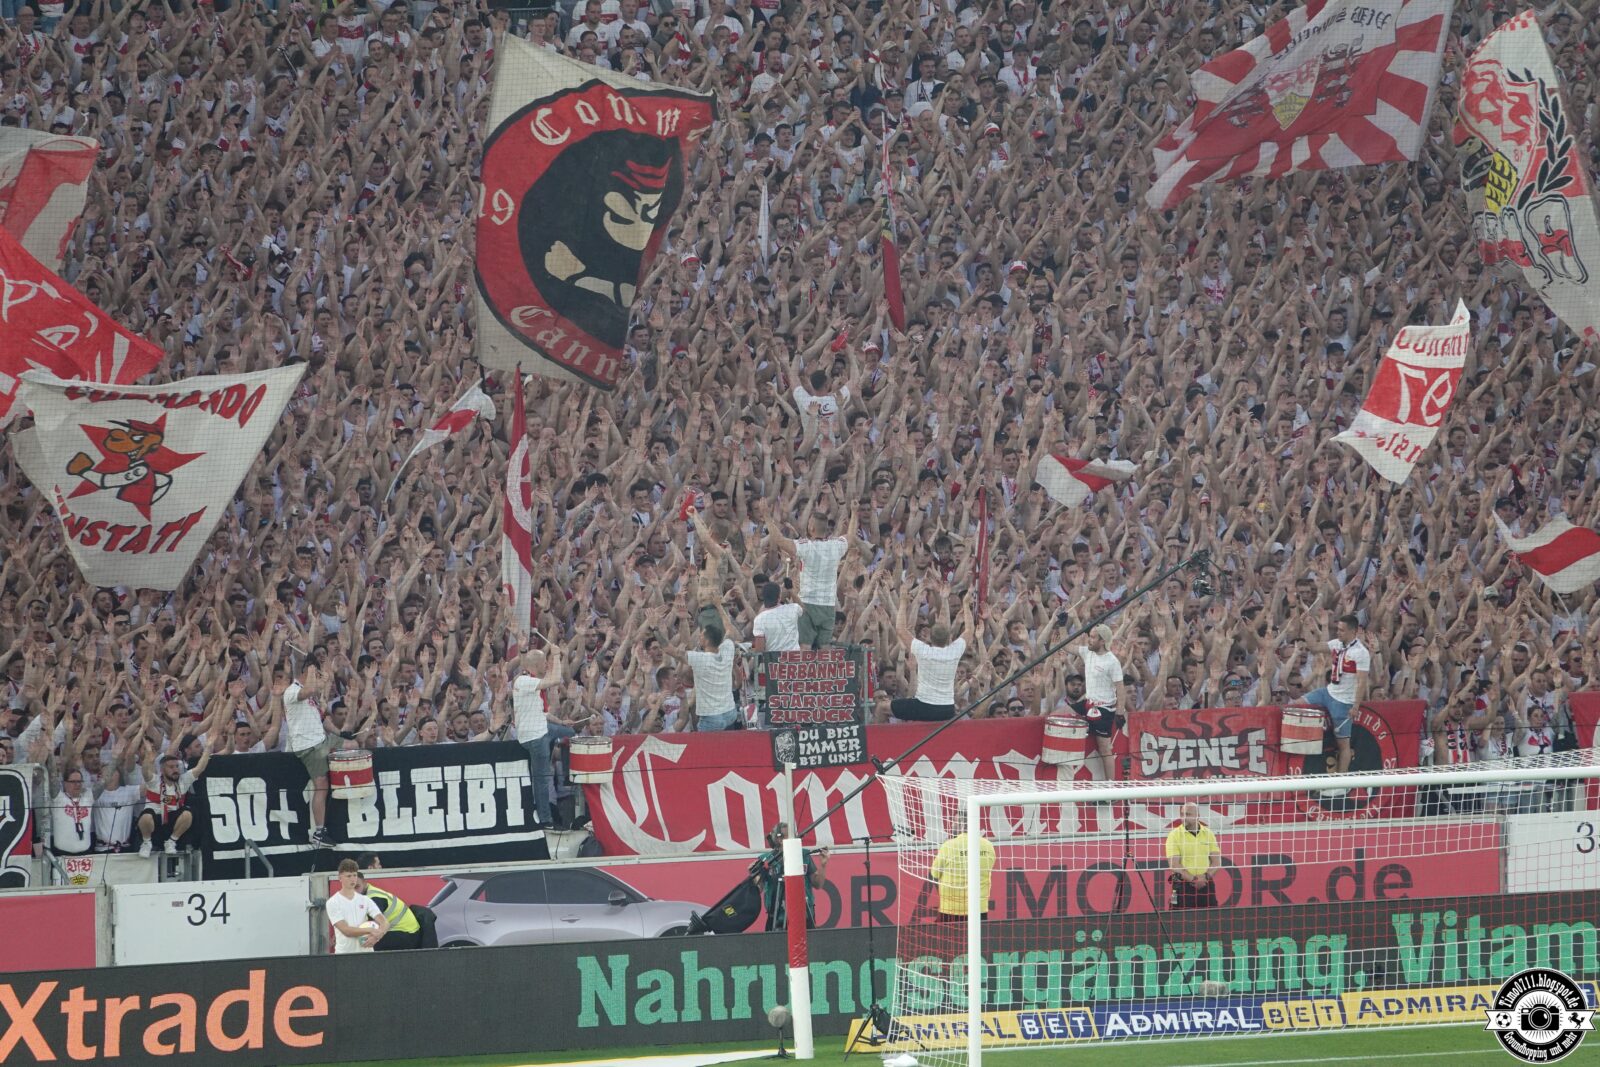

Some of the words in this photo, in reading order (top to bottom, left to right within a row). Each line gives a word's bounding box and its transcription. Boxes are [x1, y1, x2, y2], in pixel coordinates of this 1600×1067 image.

[777, 649, 847, 663] JEDER
[768, 661, 856, 680] VERBANNTE
[777, 679, 848, 694] KEHRT
[798, 729, 820, 742] DU
[826, 725, 859, 739] BIST
[798, 739, 861, 755] IMMER
[1140, 730, 1240, 777] SZENE
[1247, 728, 1268, 775] E
[799, 756, 823, 766] BEI
[828, 751, 862, 764] UNS!
[187, 891, 231, 926] 34
[1023, 1015, 1087, 1035] BET
[1106, 1007, 1260, 1037] ADMIRAL
[1268, 1005, 1340, 1026] BET
